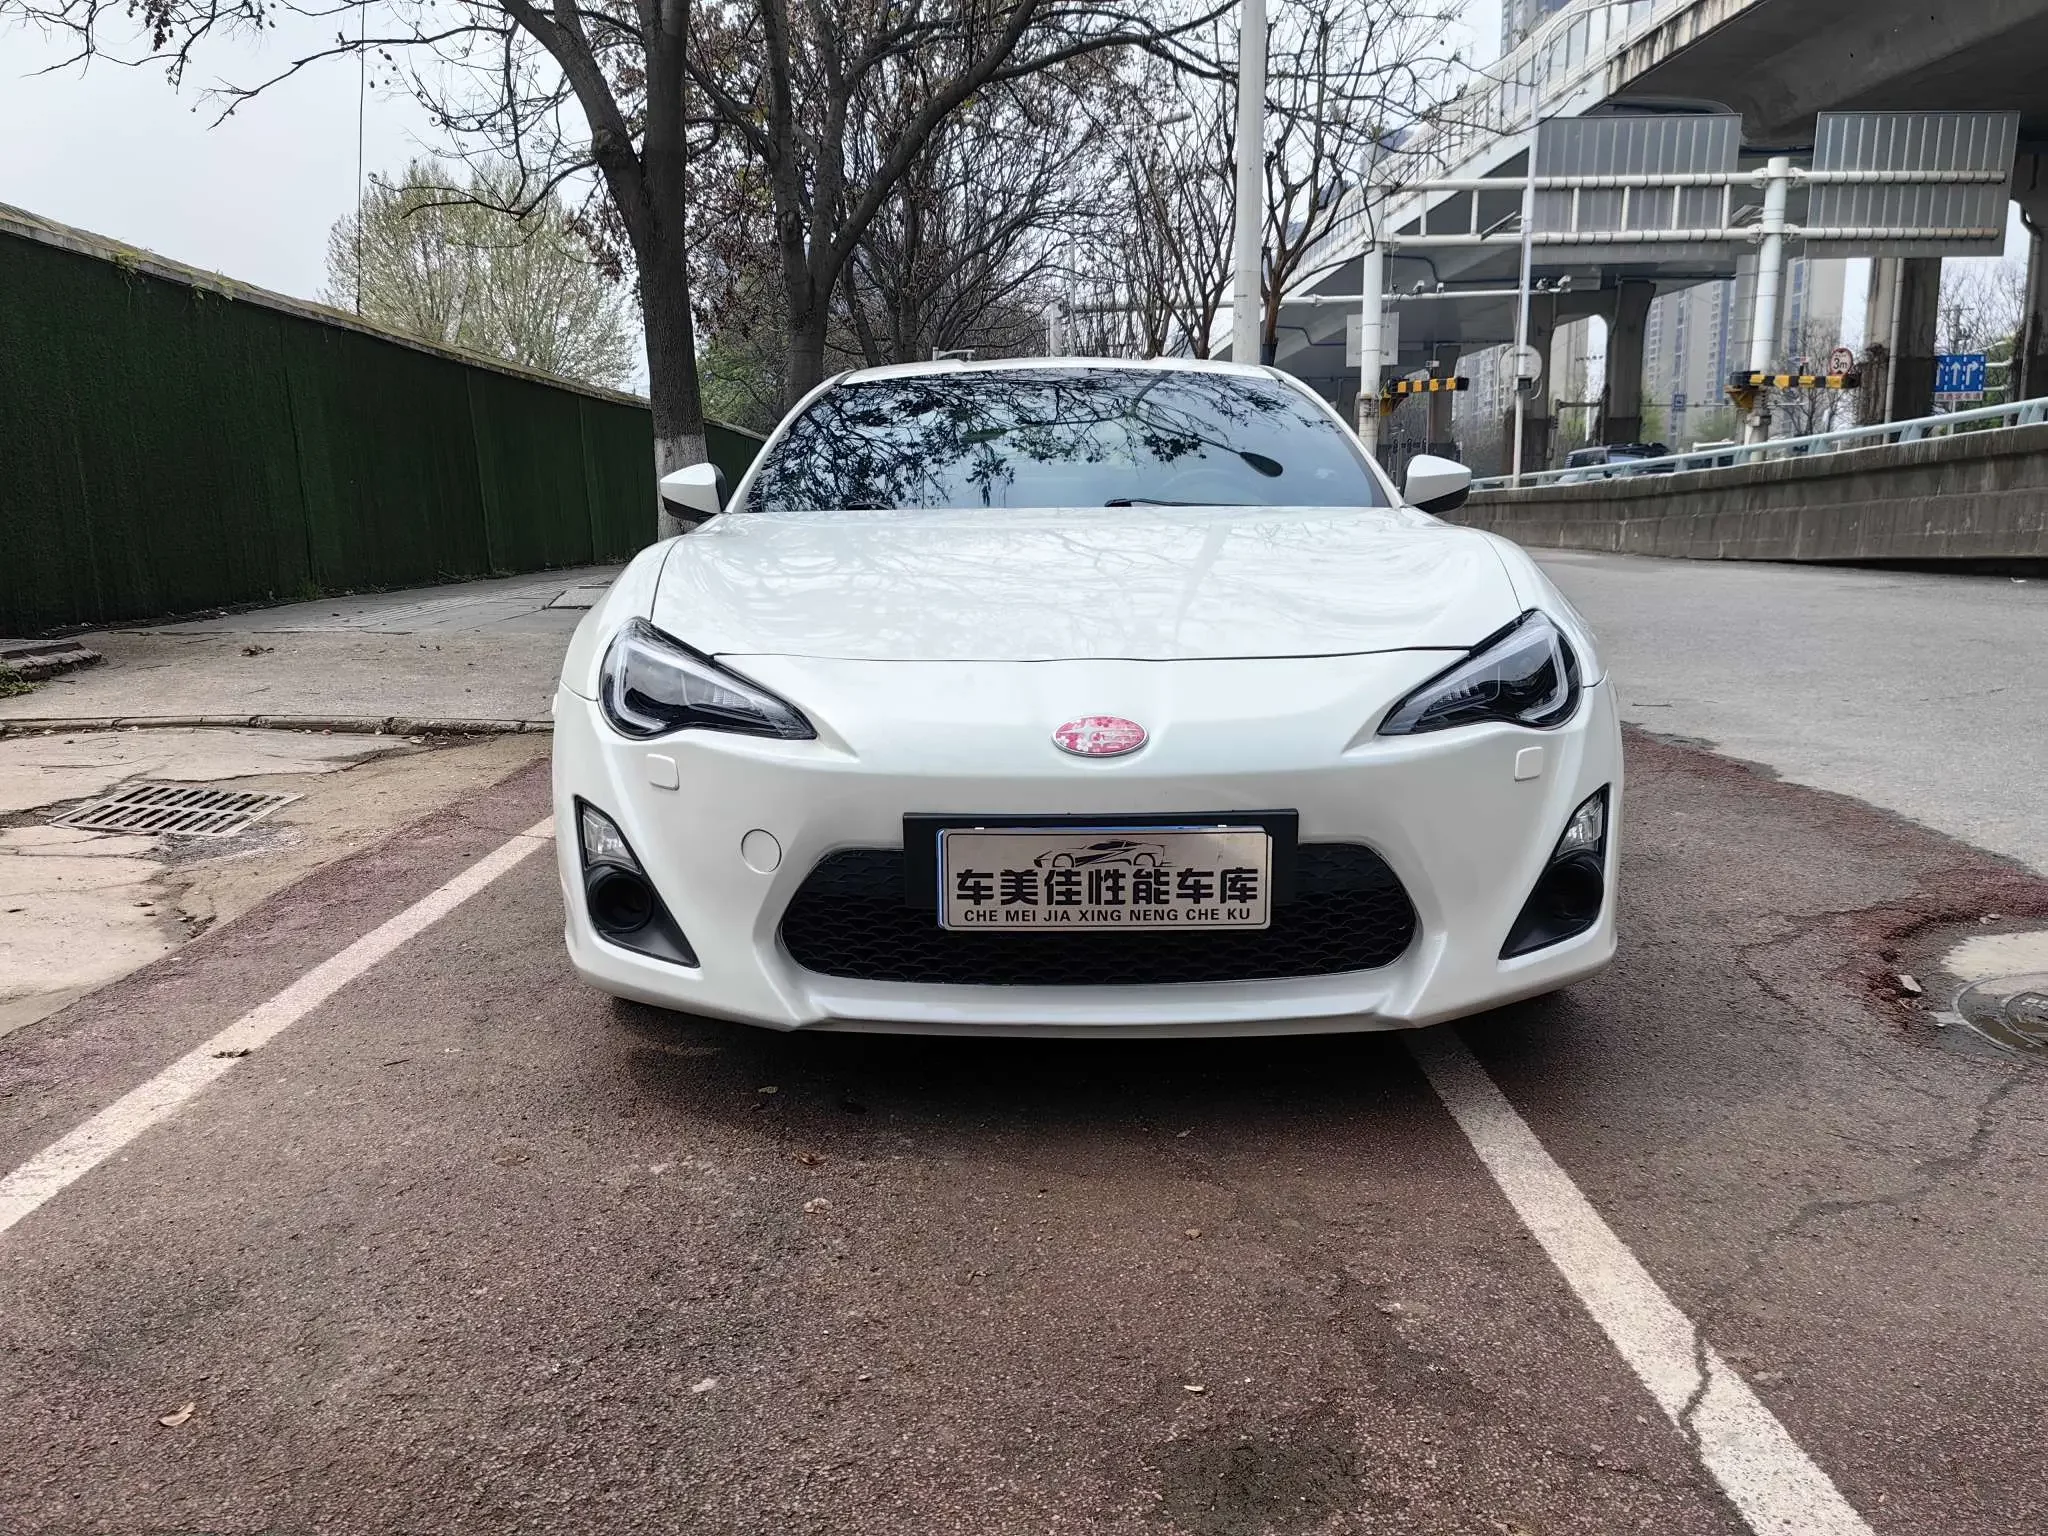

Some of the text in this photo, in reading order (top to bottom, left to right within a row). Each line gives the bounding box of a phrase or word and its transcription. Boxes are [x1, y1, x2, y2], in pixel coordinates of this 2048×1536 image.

[1833, 357, 1848, 369] 3m
[956, 868, 1259, 905] 车美佳性能车库
[964, 908, 1251, 922] CHE MEI JIA XING NENG CHE KU
